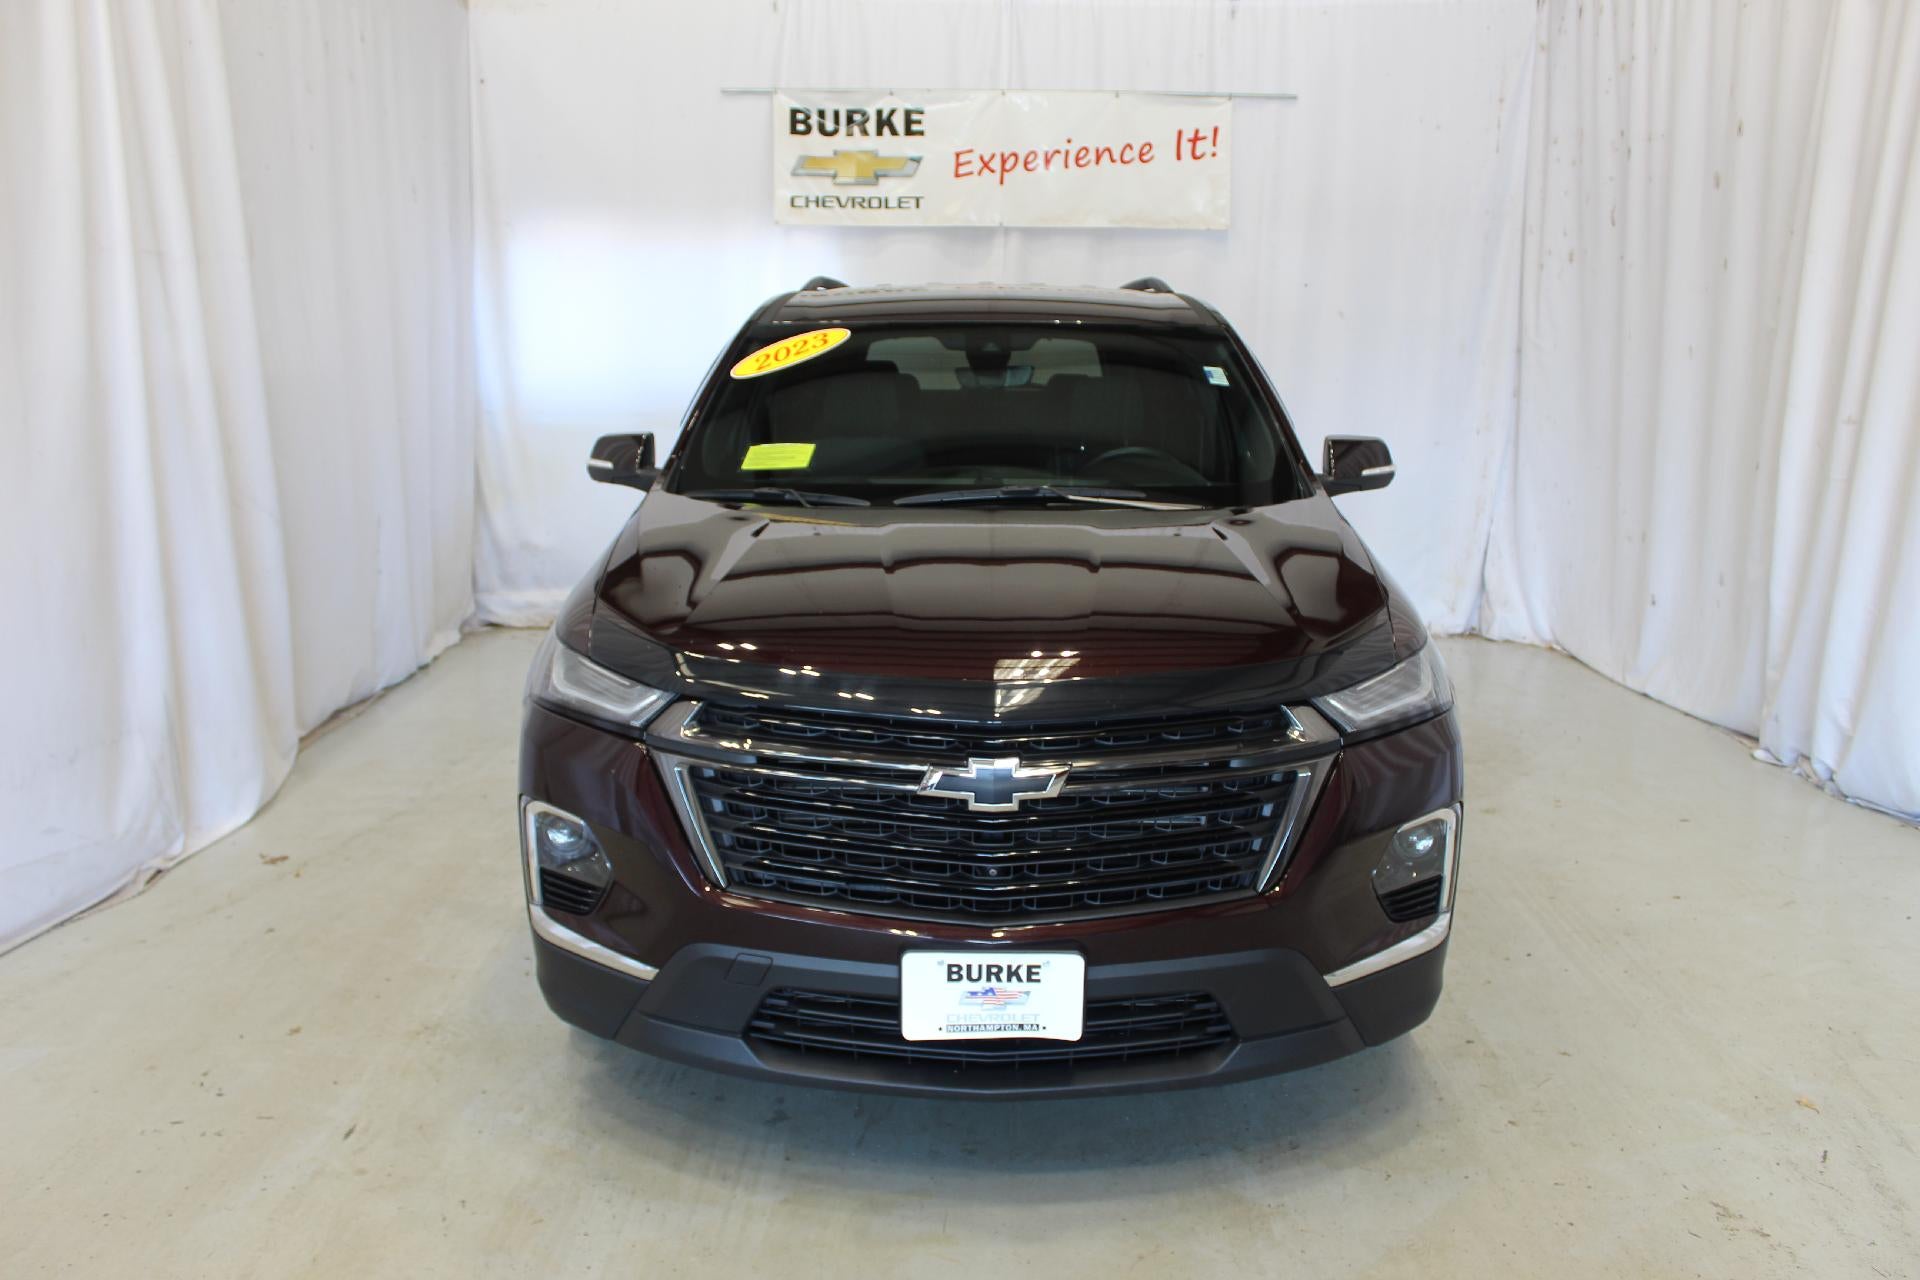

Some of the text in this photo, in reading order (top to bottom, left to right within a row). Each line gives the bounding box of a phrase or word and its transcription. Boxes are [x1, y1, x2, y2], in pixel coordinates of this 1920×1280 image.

[789, 107, 925, 137] BURKE
[953, 126, 1219, 186] Experience It!
[790, 195, 925, 209] CHEVROLET
[755, 332, 829, 371] 2023
[946, 963, 1042, 983] BURKE
[946, 1013, 1040, 1023] CHEVROLET
